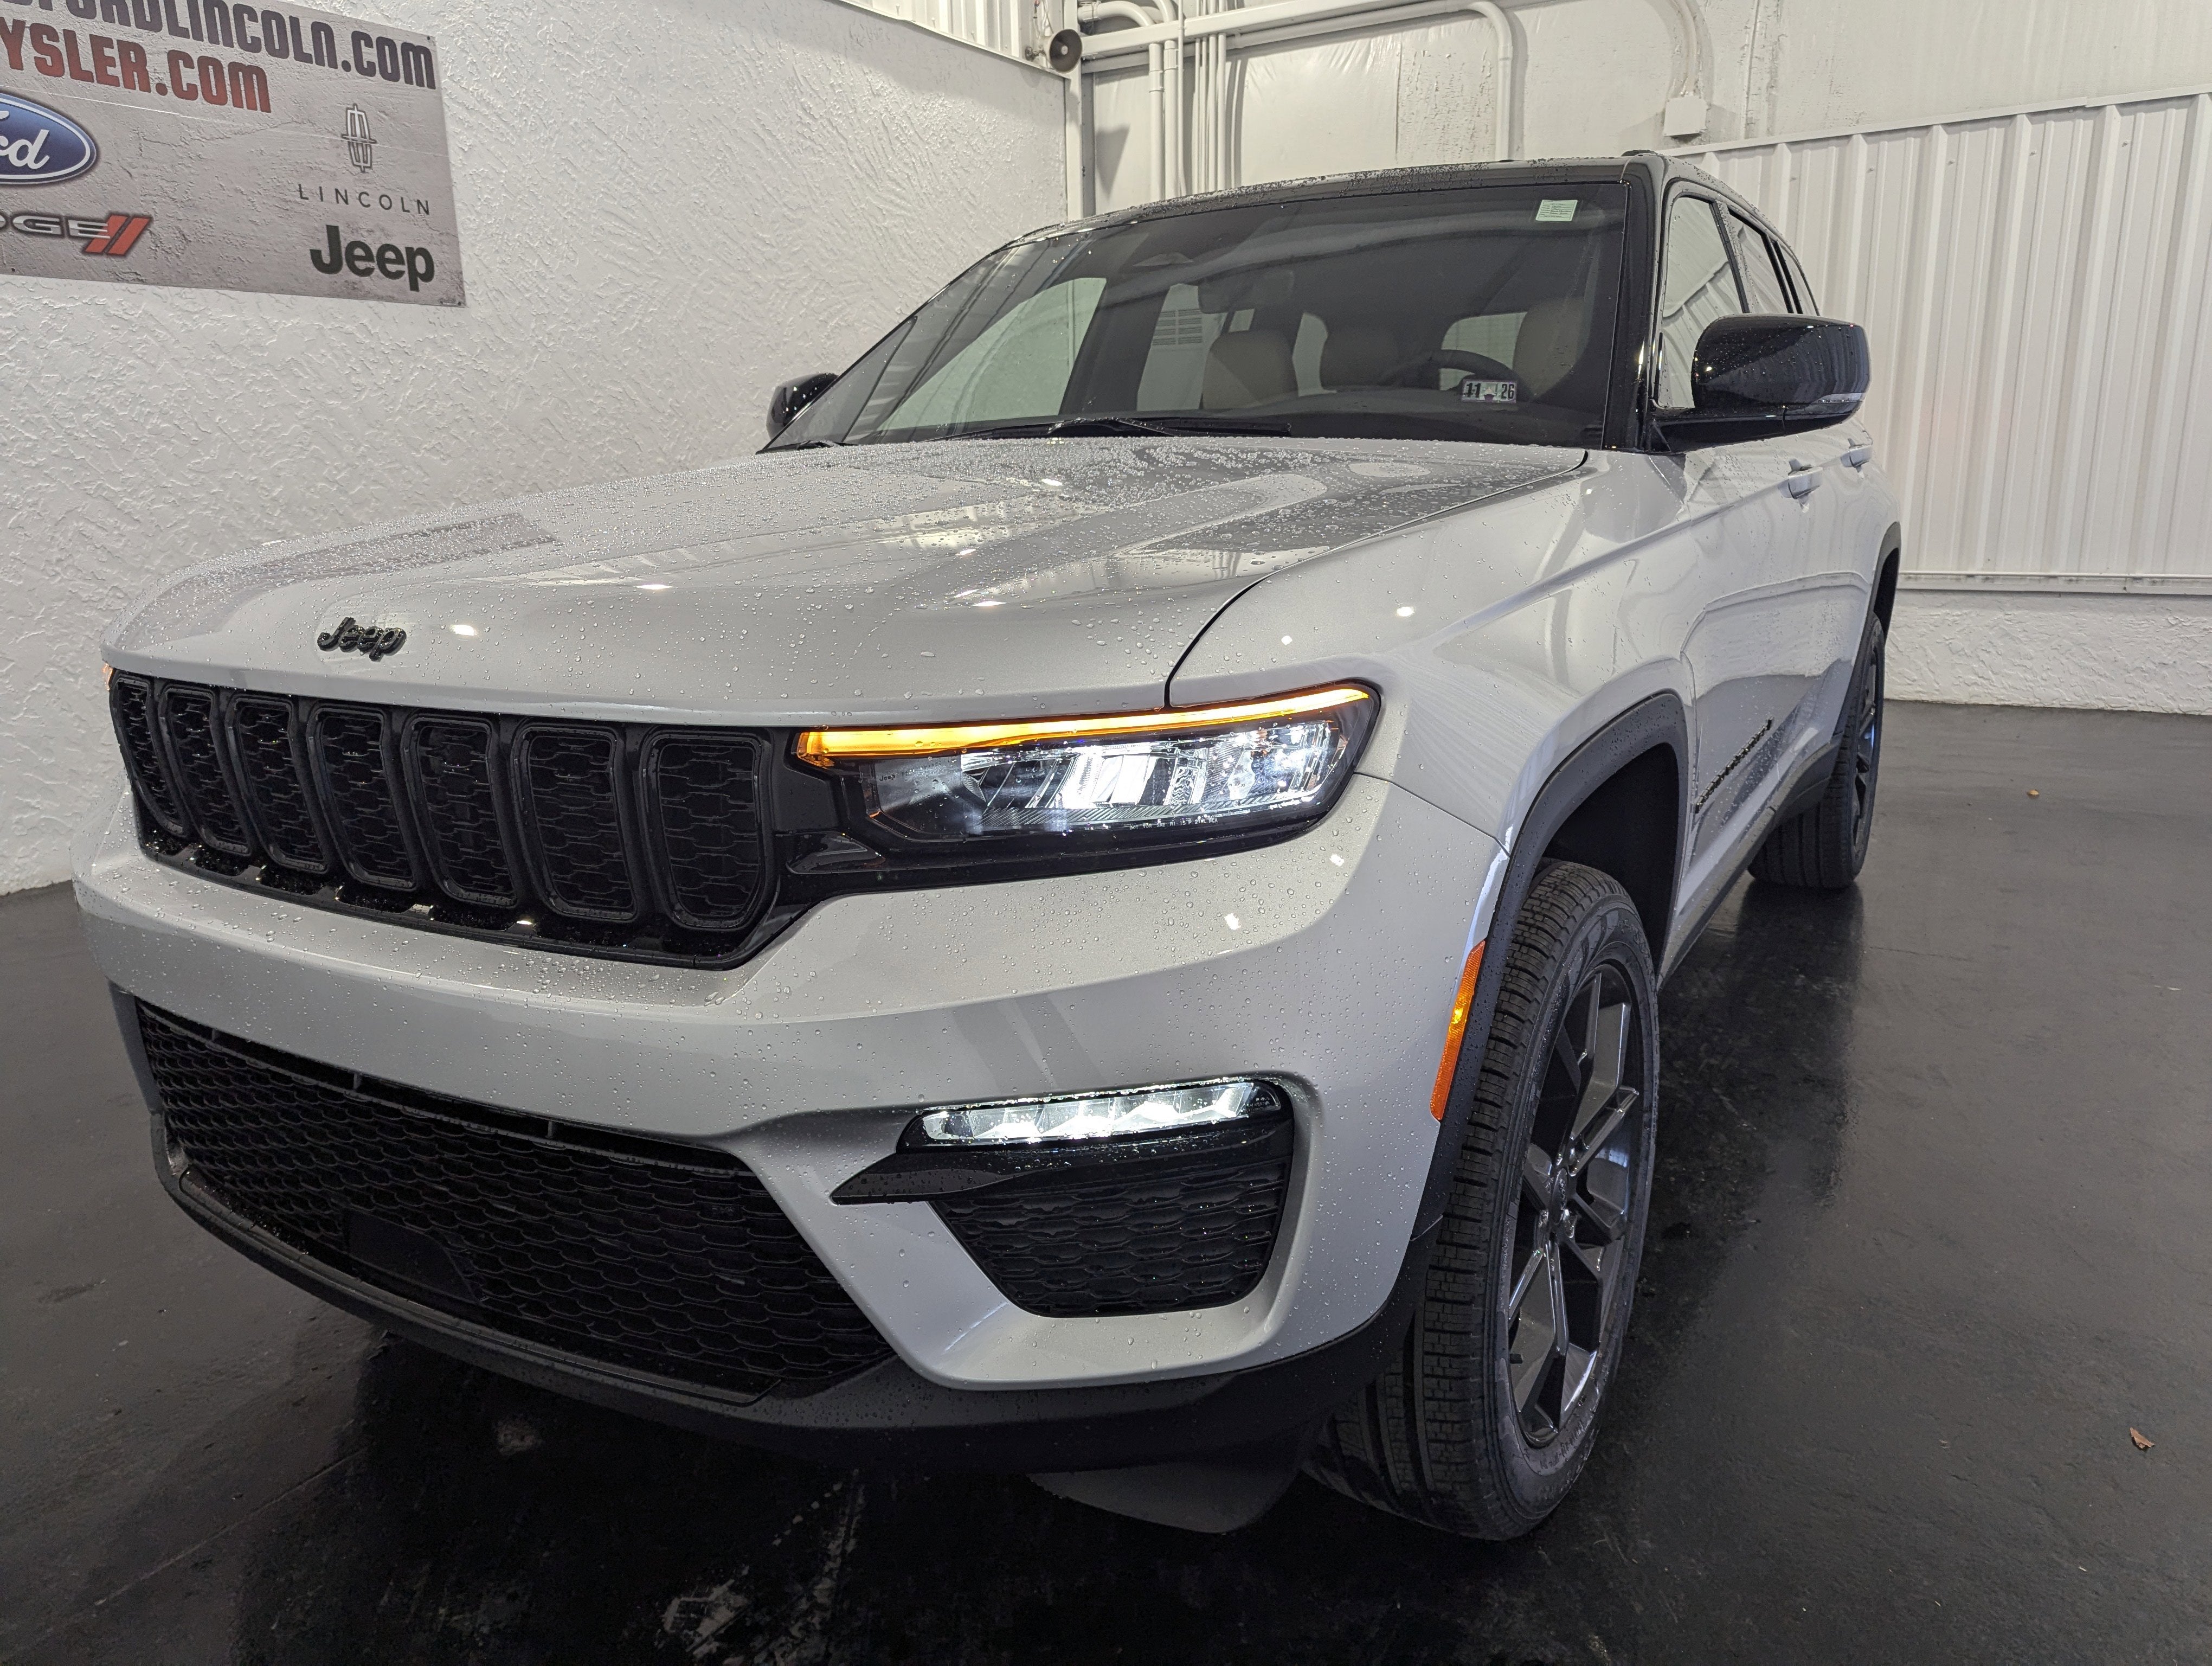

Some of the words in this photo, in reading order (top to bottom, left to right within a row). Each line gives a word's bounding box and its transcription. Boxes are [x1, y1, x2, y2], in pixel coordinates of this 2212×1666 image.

[298, 183, 430, 215] LINCOLN
[310, 225, 434, 292] Jeep
[1466, 382, 1481, 398] 11
[1501, 383, 1515, 400] 26
[317, 617, 407, 662] Jeep
